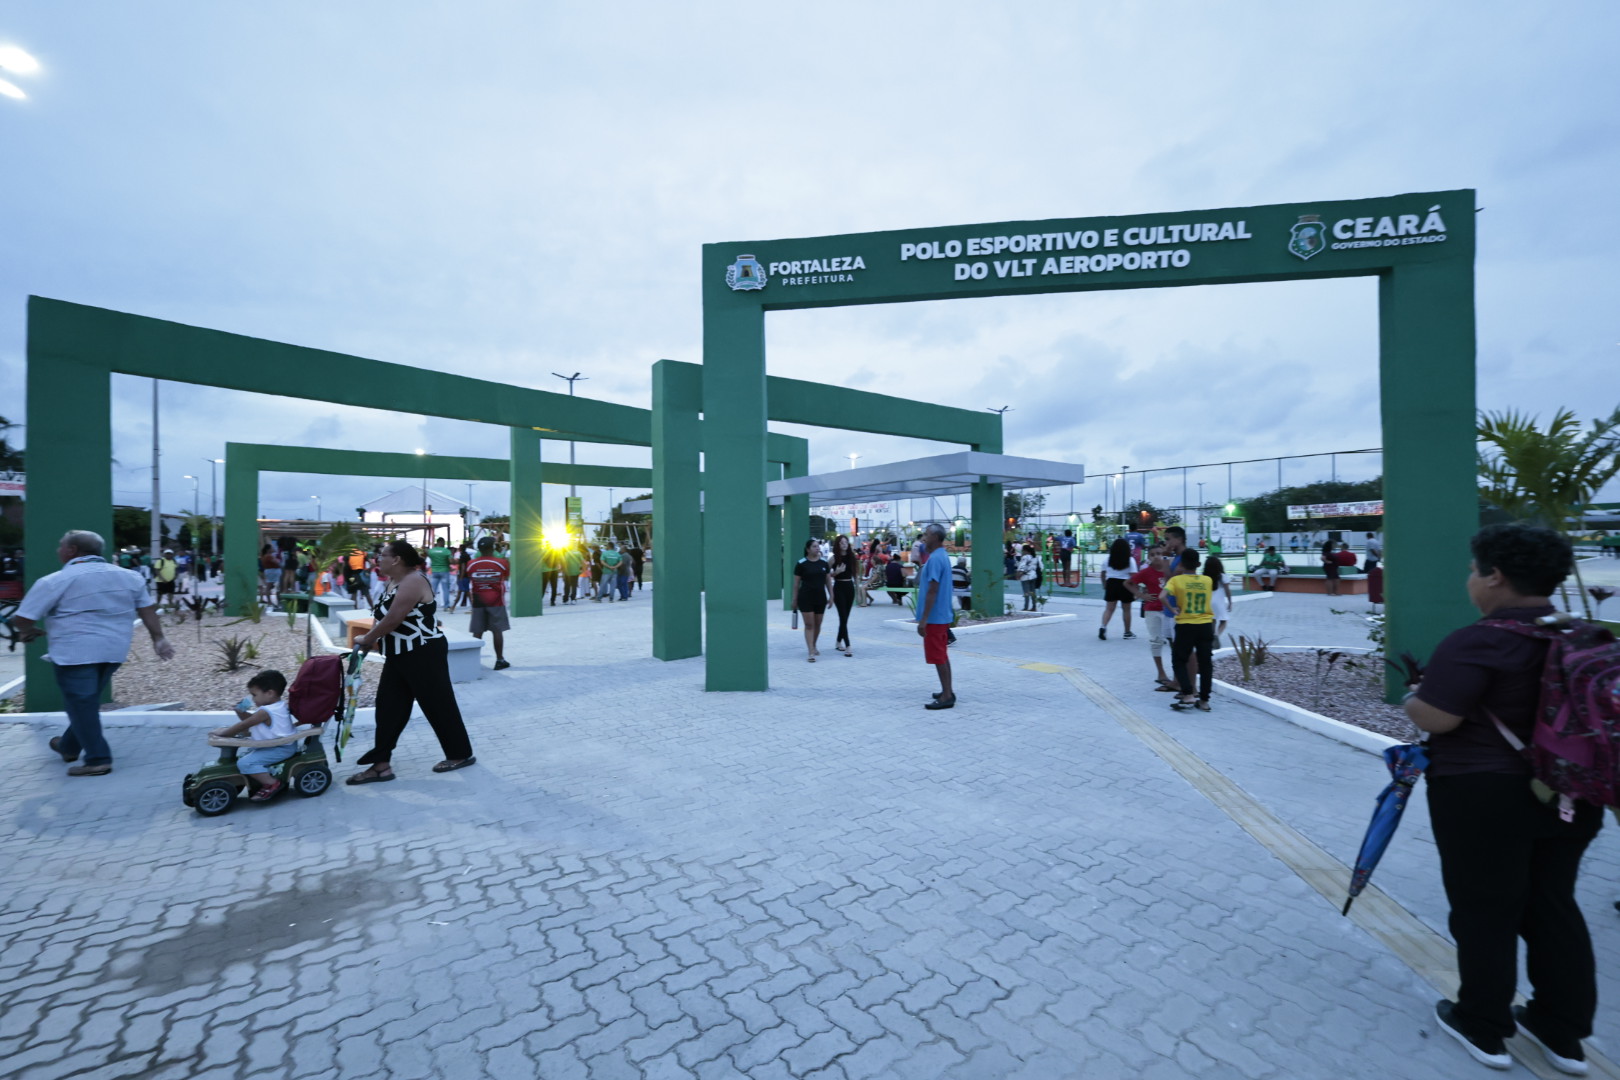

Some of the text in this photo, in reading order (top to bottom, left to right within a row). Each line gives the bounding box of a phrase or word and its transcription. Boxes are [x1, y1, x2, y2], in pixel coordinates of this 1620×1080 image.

[1332, 204, 1447, 240] CEARÁ
[900, 220, 1253, 261] POLO ESPORTIVO E CULTURAL
[1331, 234, 1447, 251] GOVERNO DO ESTADO
[769, 255, 867, 276] FORTALEZA
[954, 249, 1191, 281] DO VLT AEROPORTO
[782, 274, 854, 286] PREFEITURA
[1184, 591, 1207, 614] 10
